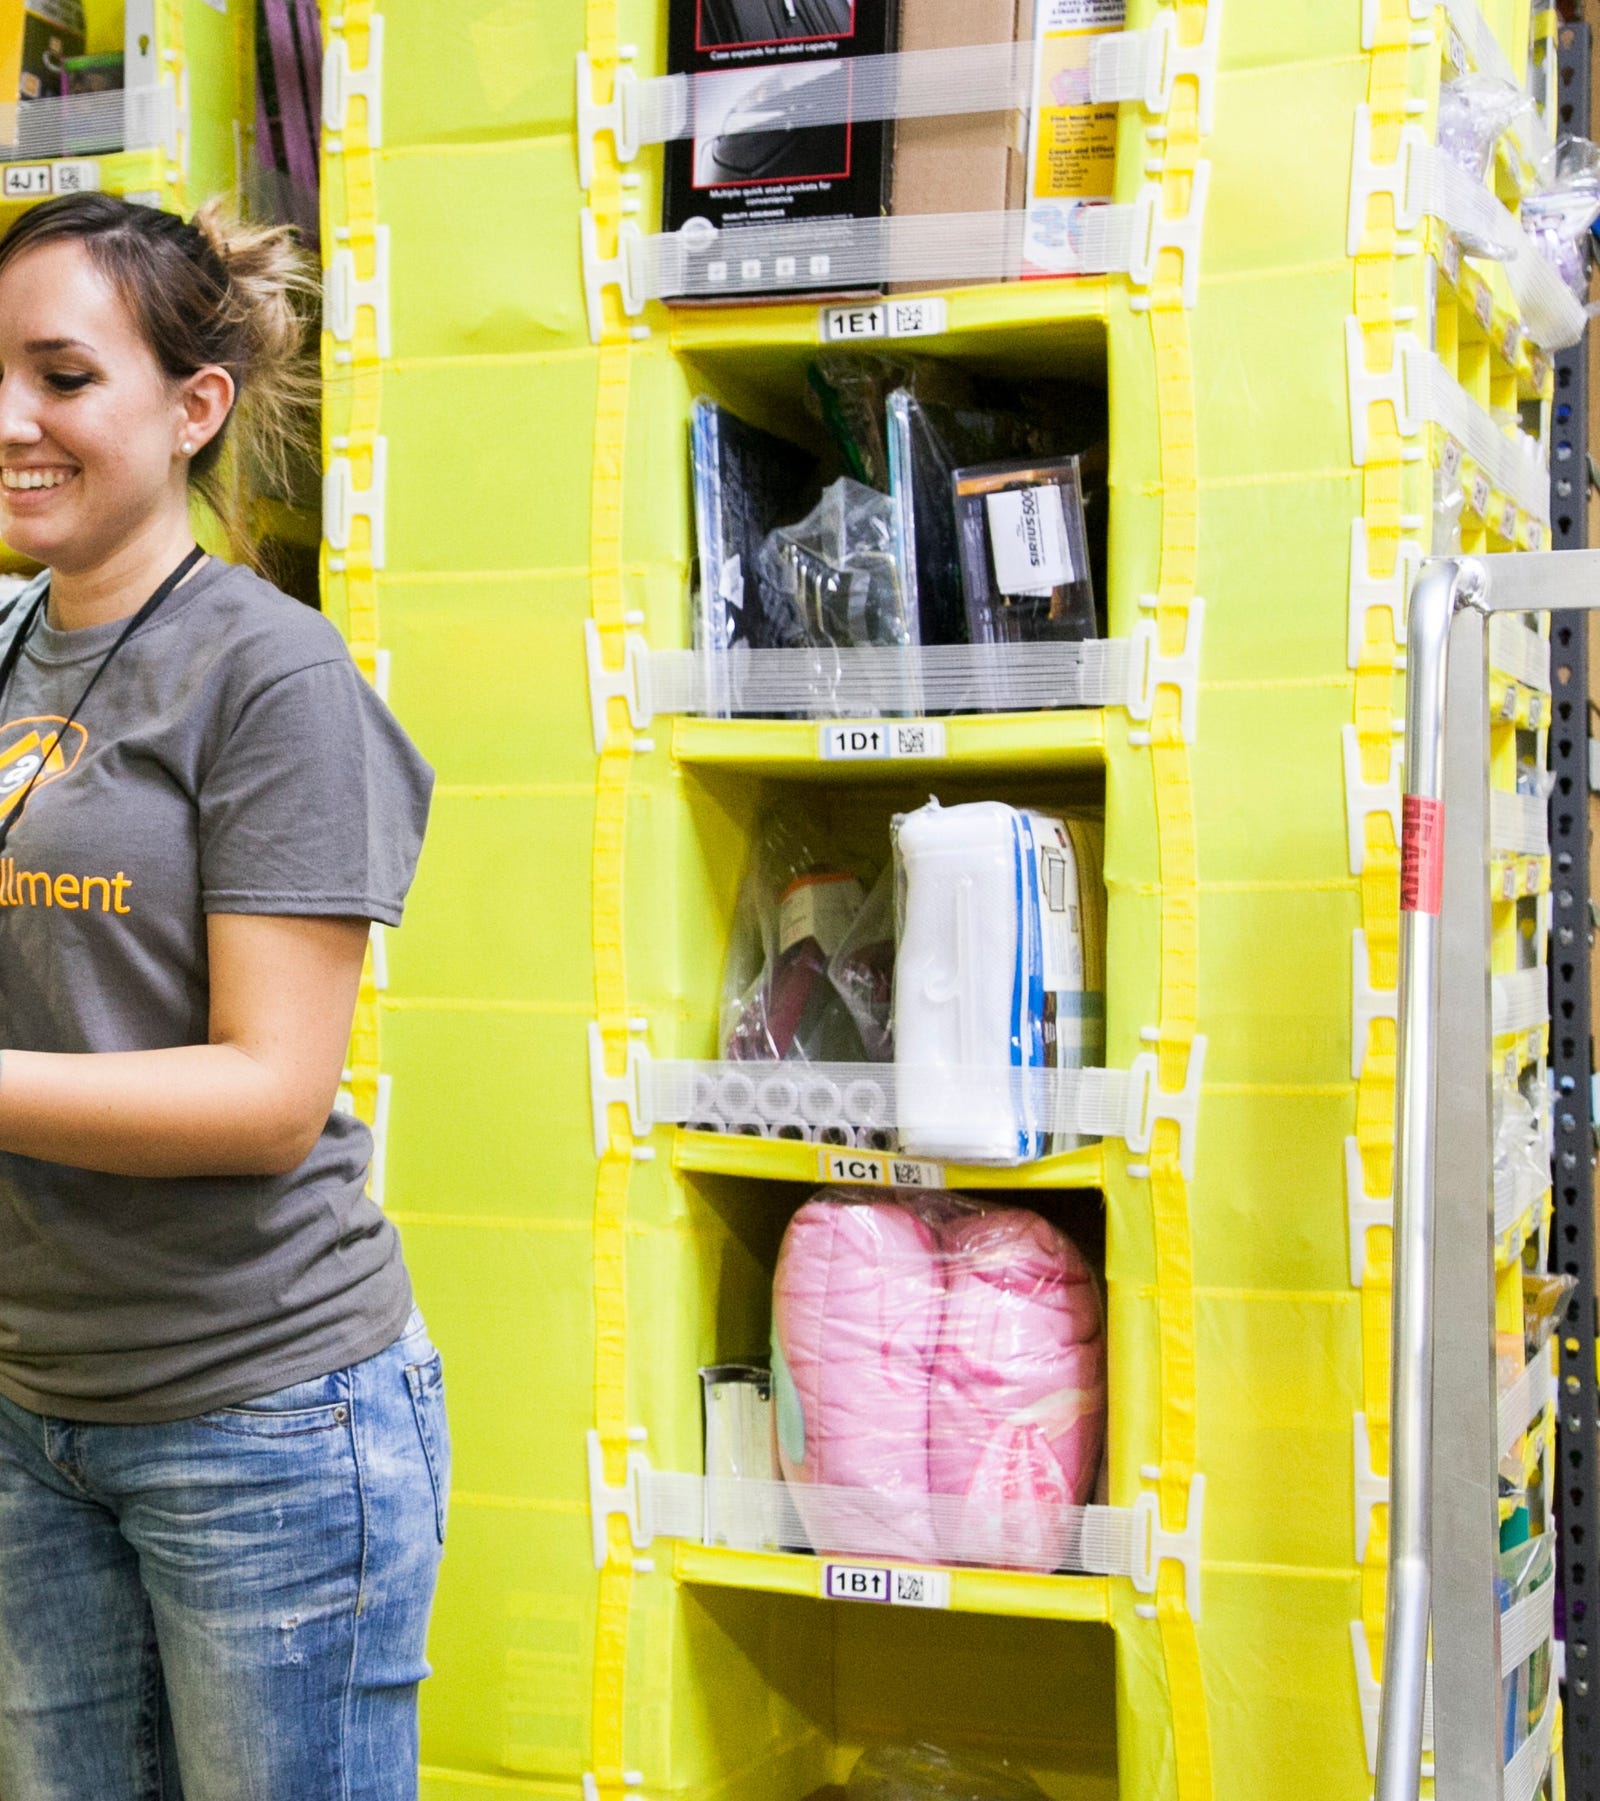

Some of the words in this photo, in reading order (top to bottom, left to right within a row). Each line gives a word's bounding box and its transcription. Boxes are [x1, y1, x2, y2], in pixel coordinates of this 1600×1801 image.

[9, 172, 32, 189] 4J
[833, 312, 864, 334] 1E
[836, 731, 868, 751] 1D
[833, 1160, 866, 1179] 1C
[836, 1572, 868, 1593] 1B
